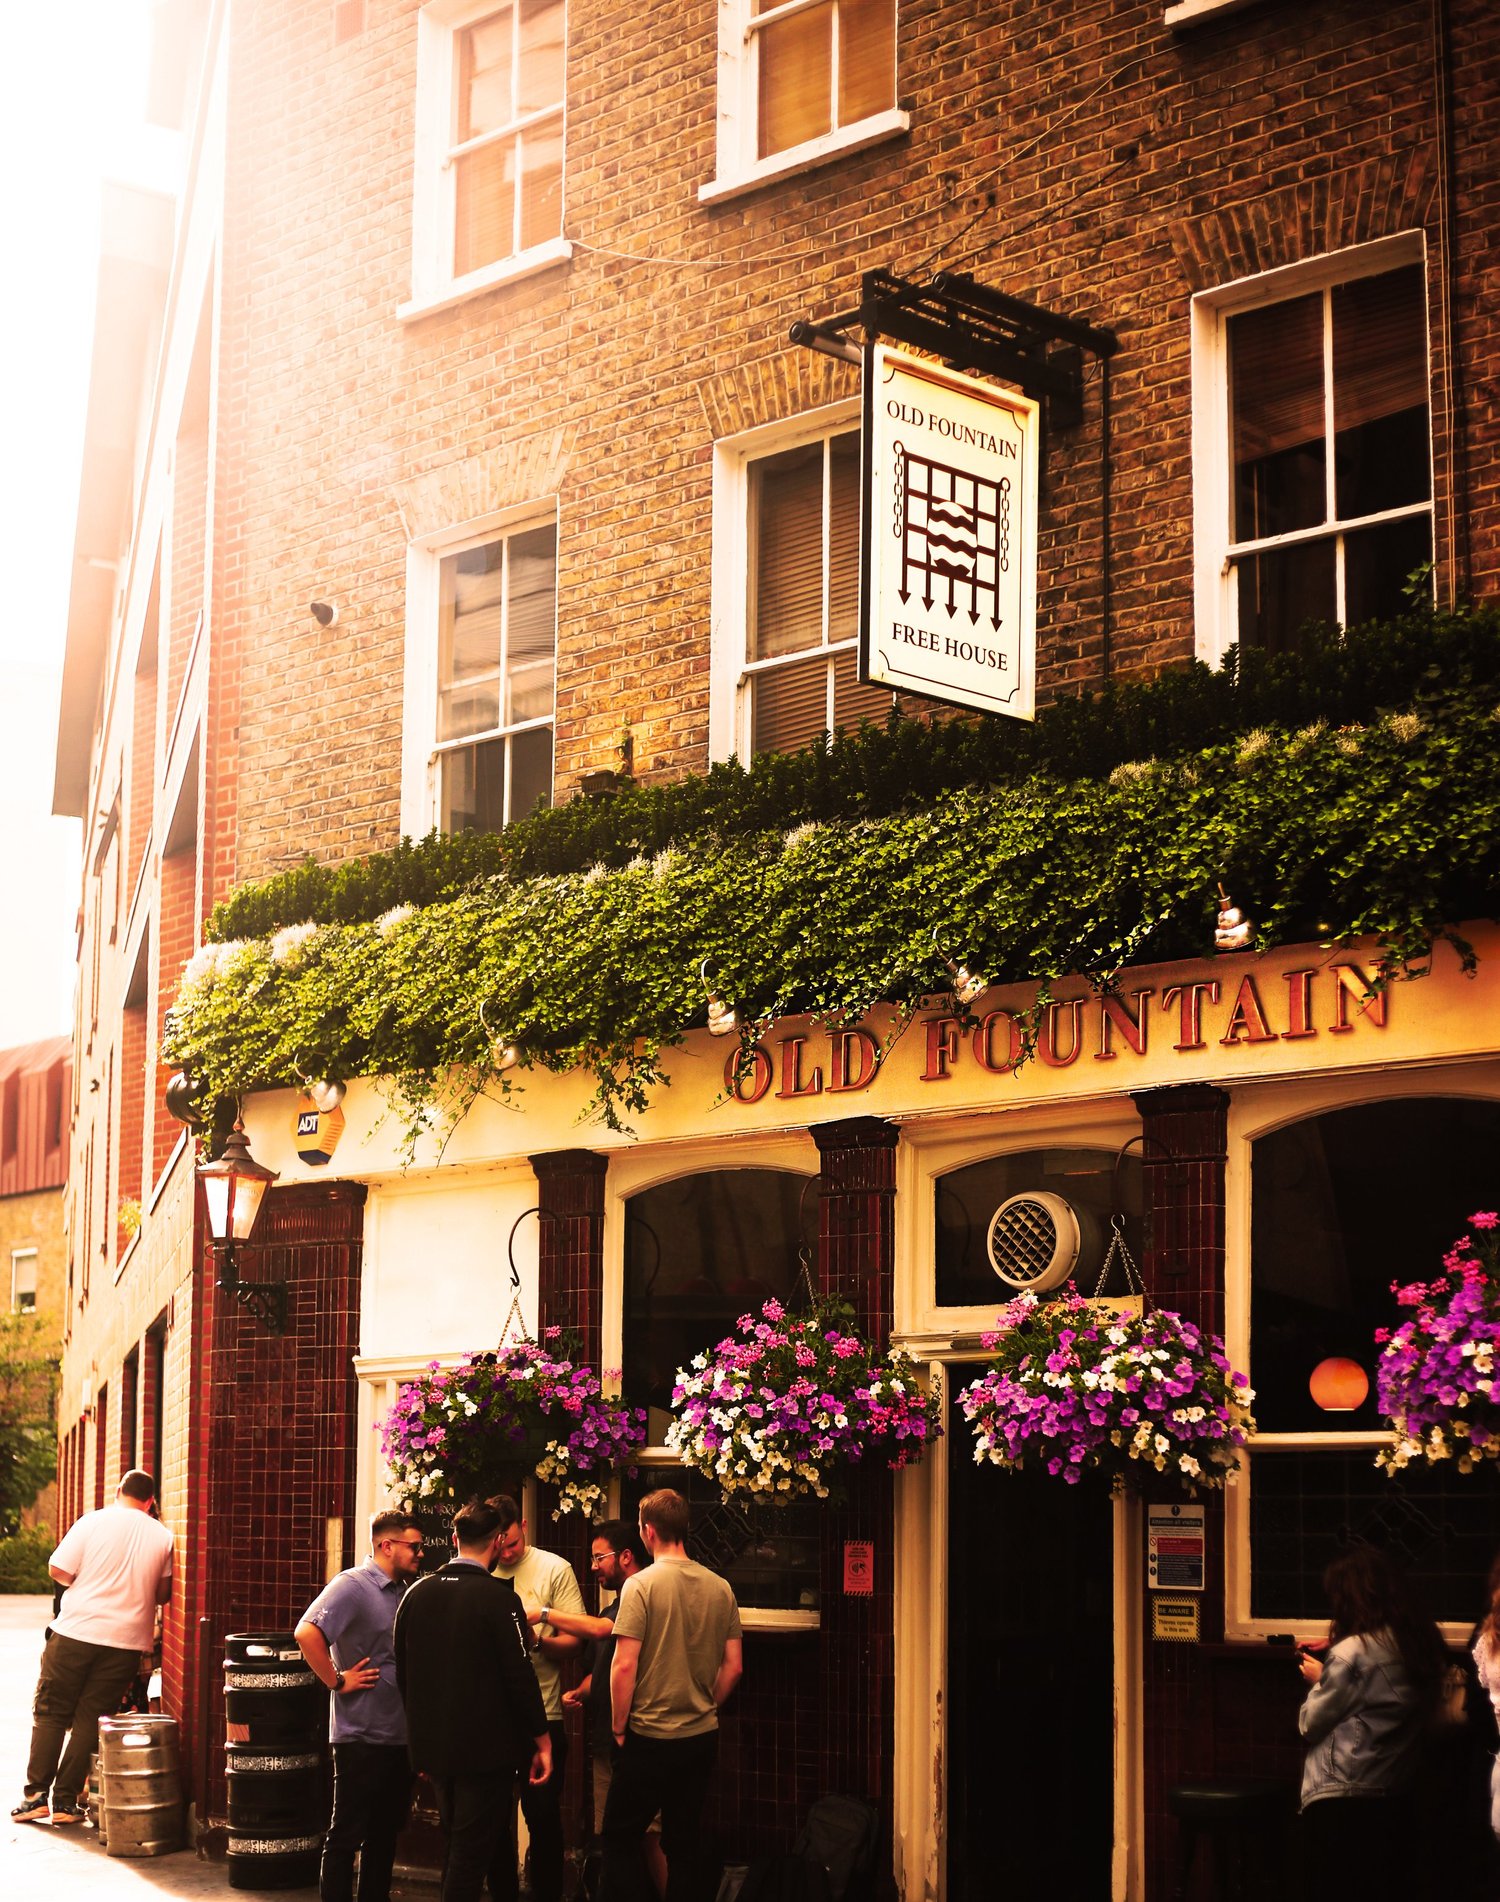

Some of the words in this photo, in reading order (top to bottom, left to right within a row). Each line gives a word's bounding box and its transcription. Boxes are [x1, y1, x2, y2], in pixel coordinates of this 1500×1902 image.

[887, 400, 924, 426] OLD
[928, 413, 1017, 460] FOUNTAIN
[892, 622, 940, 652] FREE
[944, 637, 1008, 671] HOUSE
[723, 1030, 880, 1105] OLD
[919, 958, 1389, 1082] FOUNTAIN
[298, 1114, 319, 1133] ADT
[418, 1504, 434, 1514] NEW
[435, 1504, 456, 1516] ORK
